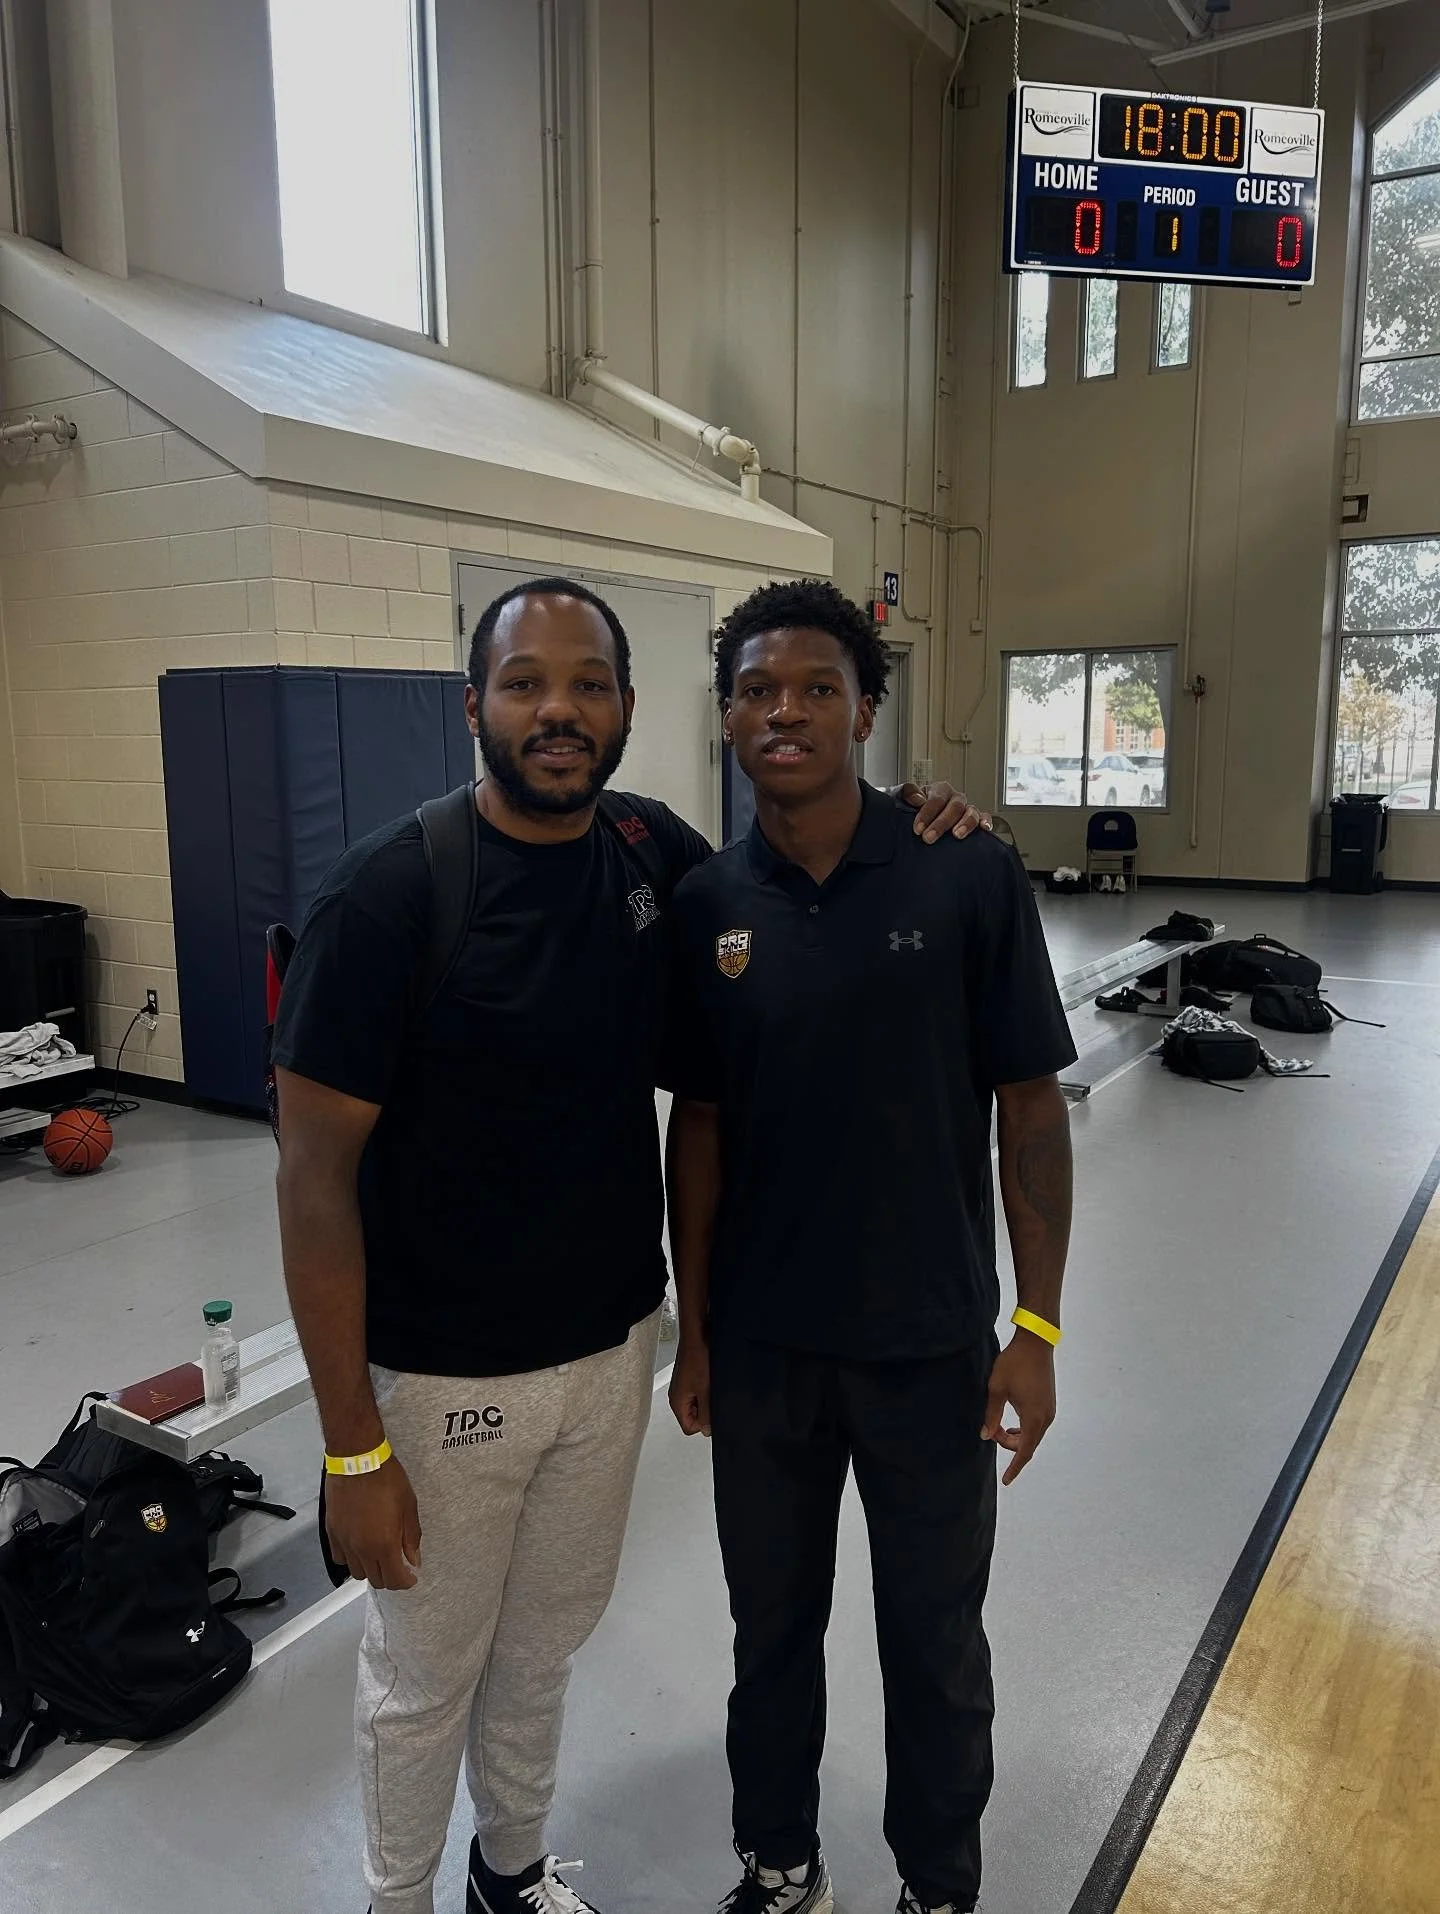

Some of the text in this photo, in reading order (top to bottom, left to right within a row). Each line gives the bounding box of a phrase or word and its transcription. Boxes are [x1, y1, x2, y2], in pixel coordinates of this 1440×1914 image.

[1024, 107, 1091, 130] Romeoville
[1125, 103, 1240, 162] 18:00
[1254, 128, 1316, 149] Romeoville
[1034, 161, 1099, 191] HOME
[1143, 185, 1196, 206] PERIOD
[1235, 177, 1305, 207] GUEST
[1074, 201, 1101, 255] 0
[1170, 216, 1180, 251] 1
[1275, 216, 1303, 269] 0
[885, 576, 898, 601] 13
[718, 933, 749, 949] PRO
[441, 1429, 504, 1450] BASKETBALL
